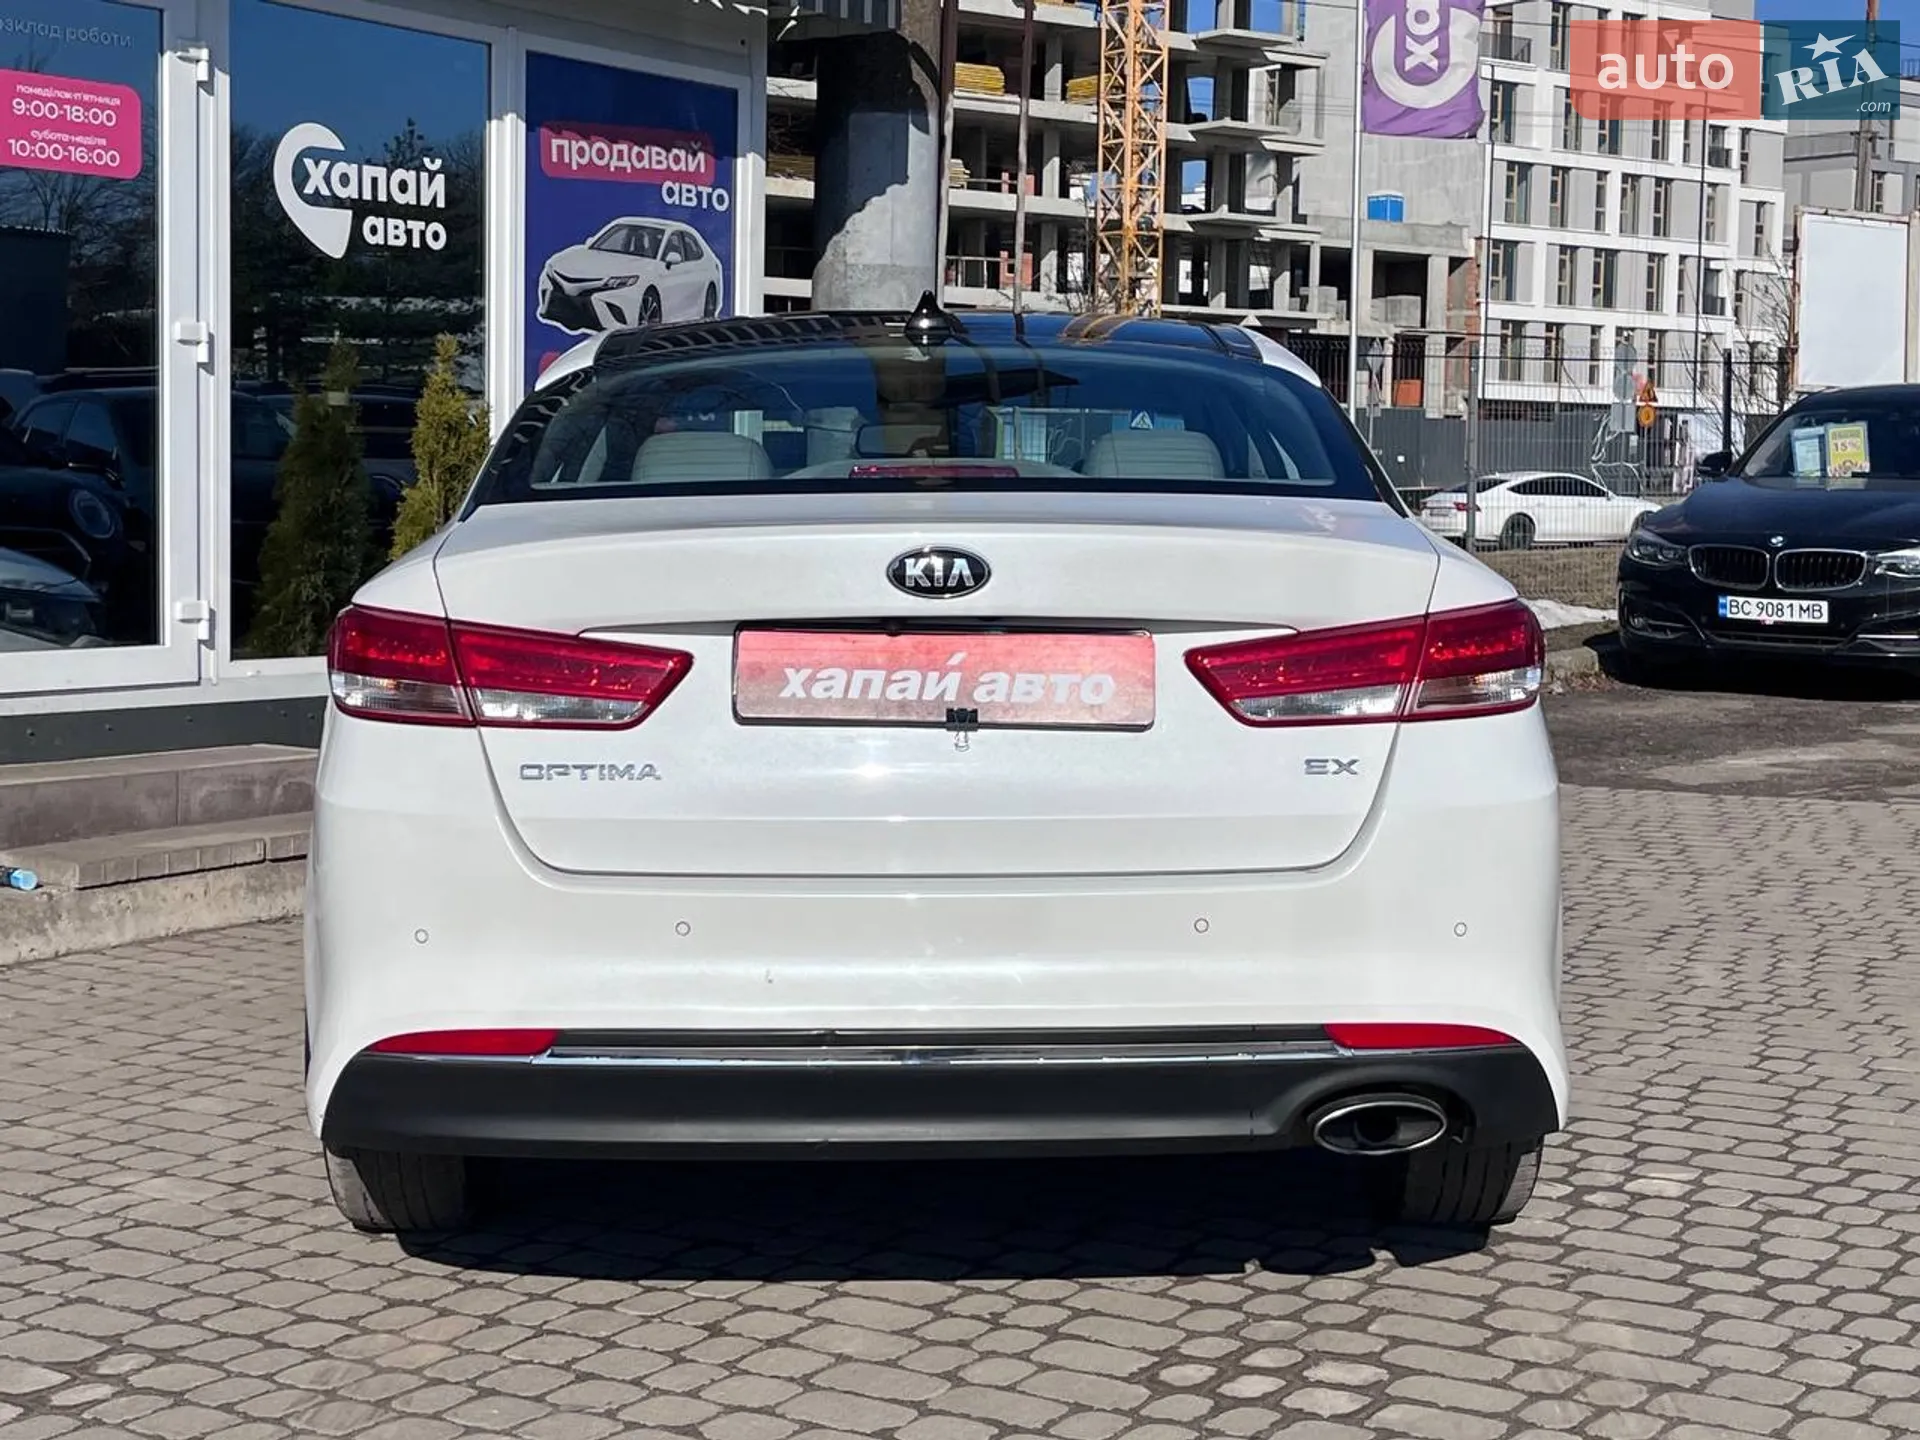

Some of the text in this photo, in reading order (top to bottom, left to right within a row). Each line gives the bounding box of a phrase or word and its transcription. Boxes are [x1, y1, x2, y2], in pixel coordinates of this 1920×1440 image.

[65, 26, 132, 47] роботи
[12, 98, 117, 127] 9:00-18:00
[8, 139, 121, 168] 10:00-16:00
[551, 138, 706, 174] продавай
[302, 156, 446, 208] хапай
[661, 180, 730, 212] авто
[362, 215, 447, 251] авто
[905, 556, 976, 588] KIA
[1729, 599, 1752, 616] BC
[1756, 601, 1794, 619] 9081
[1799, 603, 1824, 620] MB
[972, 670, 1118, 705] авто
[519, 763, 662, 781] OPTIMA
[1304, 758, 1360, 775] EX
